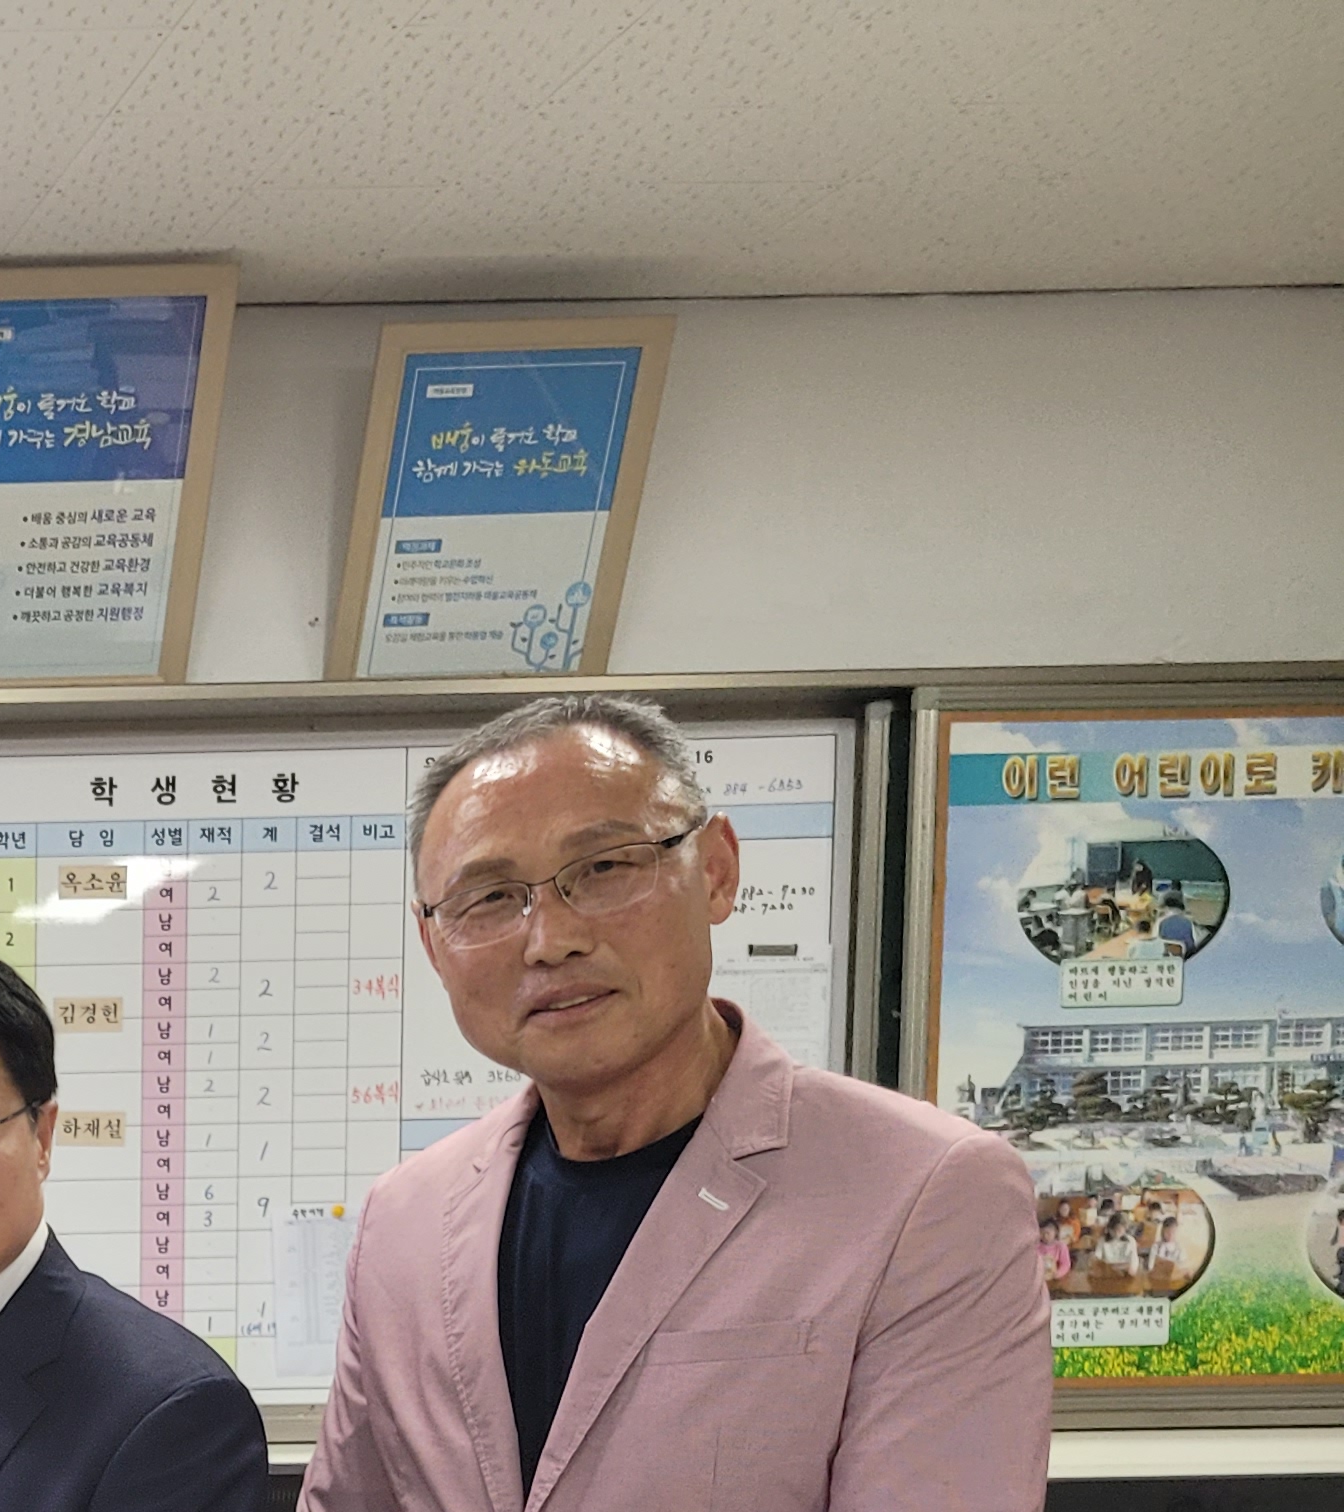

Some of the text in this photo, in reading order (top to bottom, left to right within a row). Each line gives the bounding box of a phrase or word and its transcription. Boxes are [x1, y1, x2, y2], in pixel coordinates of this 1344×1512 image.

[97, 390, 136, 414] 학교
[63, 418, 151, 448] 경남교육
[543, 423, 578, 447] 학교
[412, 458, 457, 482] 함께
[31, 513, 52, 525] 배움
[91, 509, 127, 523] 새로운
[131, 508, 157, 522] 교육
[102, 557, 151, 572] 교육환경
[1002, 753, 1081, 799] 이런
[1114, 751, 1279, 798] 어린이로
[150, 826, 184, 848] 성별
[199, 825, 234, 846] 재적
[263, 825, 279, 844] 계
[309, 821, 342, 843] 결석
[362, 820, 395, 842] 비고
[59, 868, 128, 896] 옥소윤
[61, 1117, 123, 1140] 하재설
